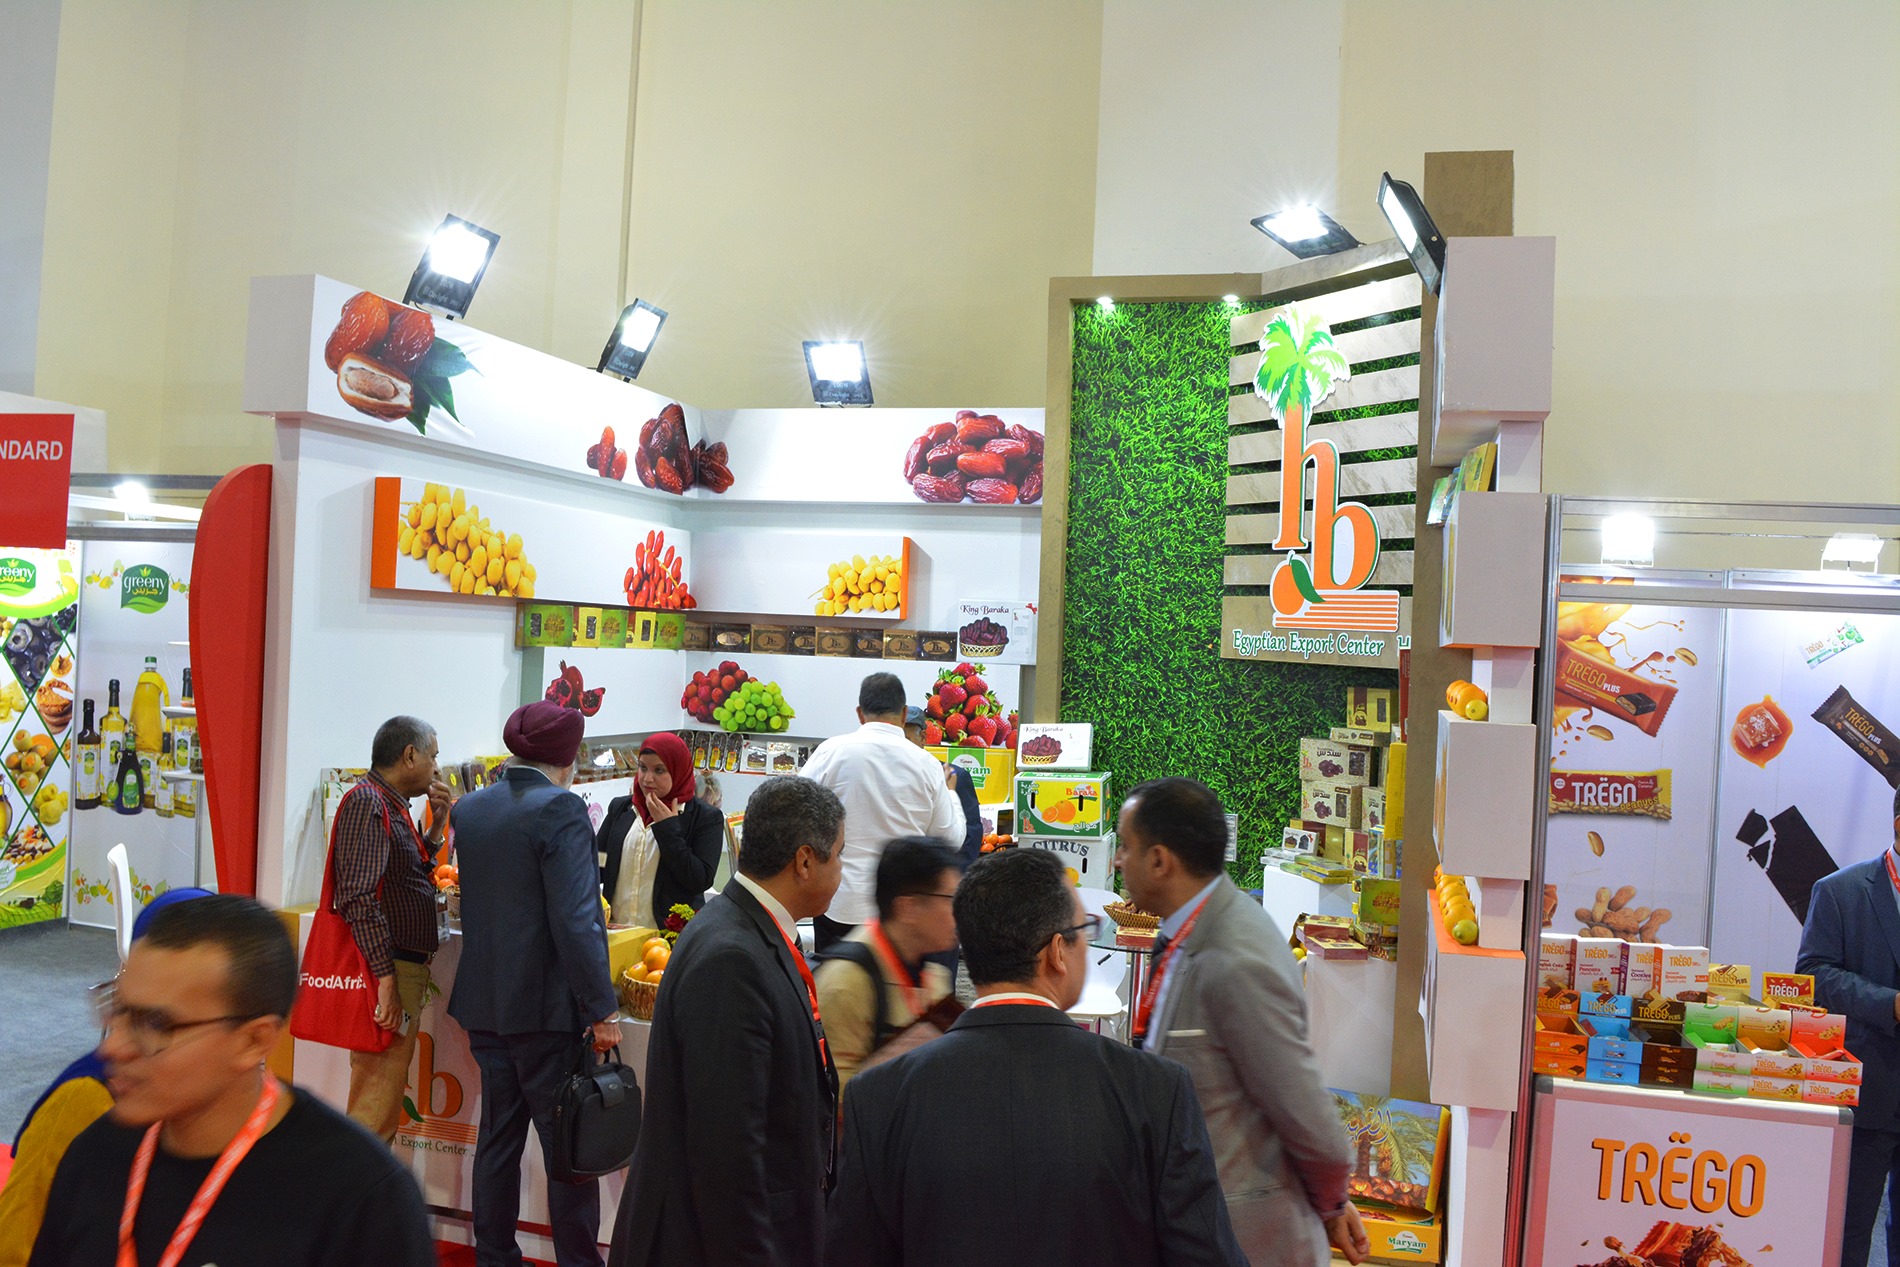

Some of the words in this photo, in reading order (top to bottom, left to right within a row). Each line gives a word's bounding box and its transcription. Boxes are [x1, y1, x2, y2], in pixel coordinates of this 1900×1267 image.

[124, 576, 168, 595] greeny
[960, 605, 979, 615] King
[980, 605, 1009, 615] Baraka
[1232, 629, 1287, 657] Egyptian
[1289, 631, 1334, 659] Export
[1336, 632, 1385, 657] Center
[1603, 682, 1621, 693] PLUS
[1867, 732, 1883, 745] PLUS
[966, 767, 991, 776] yam
[1065, 787, 1098, 796] Baraka
[1032, 840, 1090, 857] CITRUS
[1668, 1013, 1681, 1021] PLUS
[401, 1135, 432, 1150] Export
[435, 1141, 468, 1155] Center
[1387, 1236, 1428, 1249] Maryam
